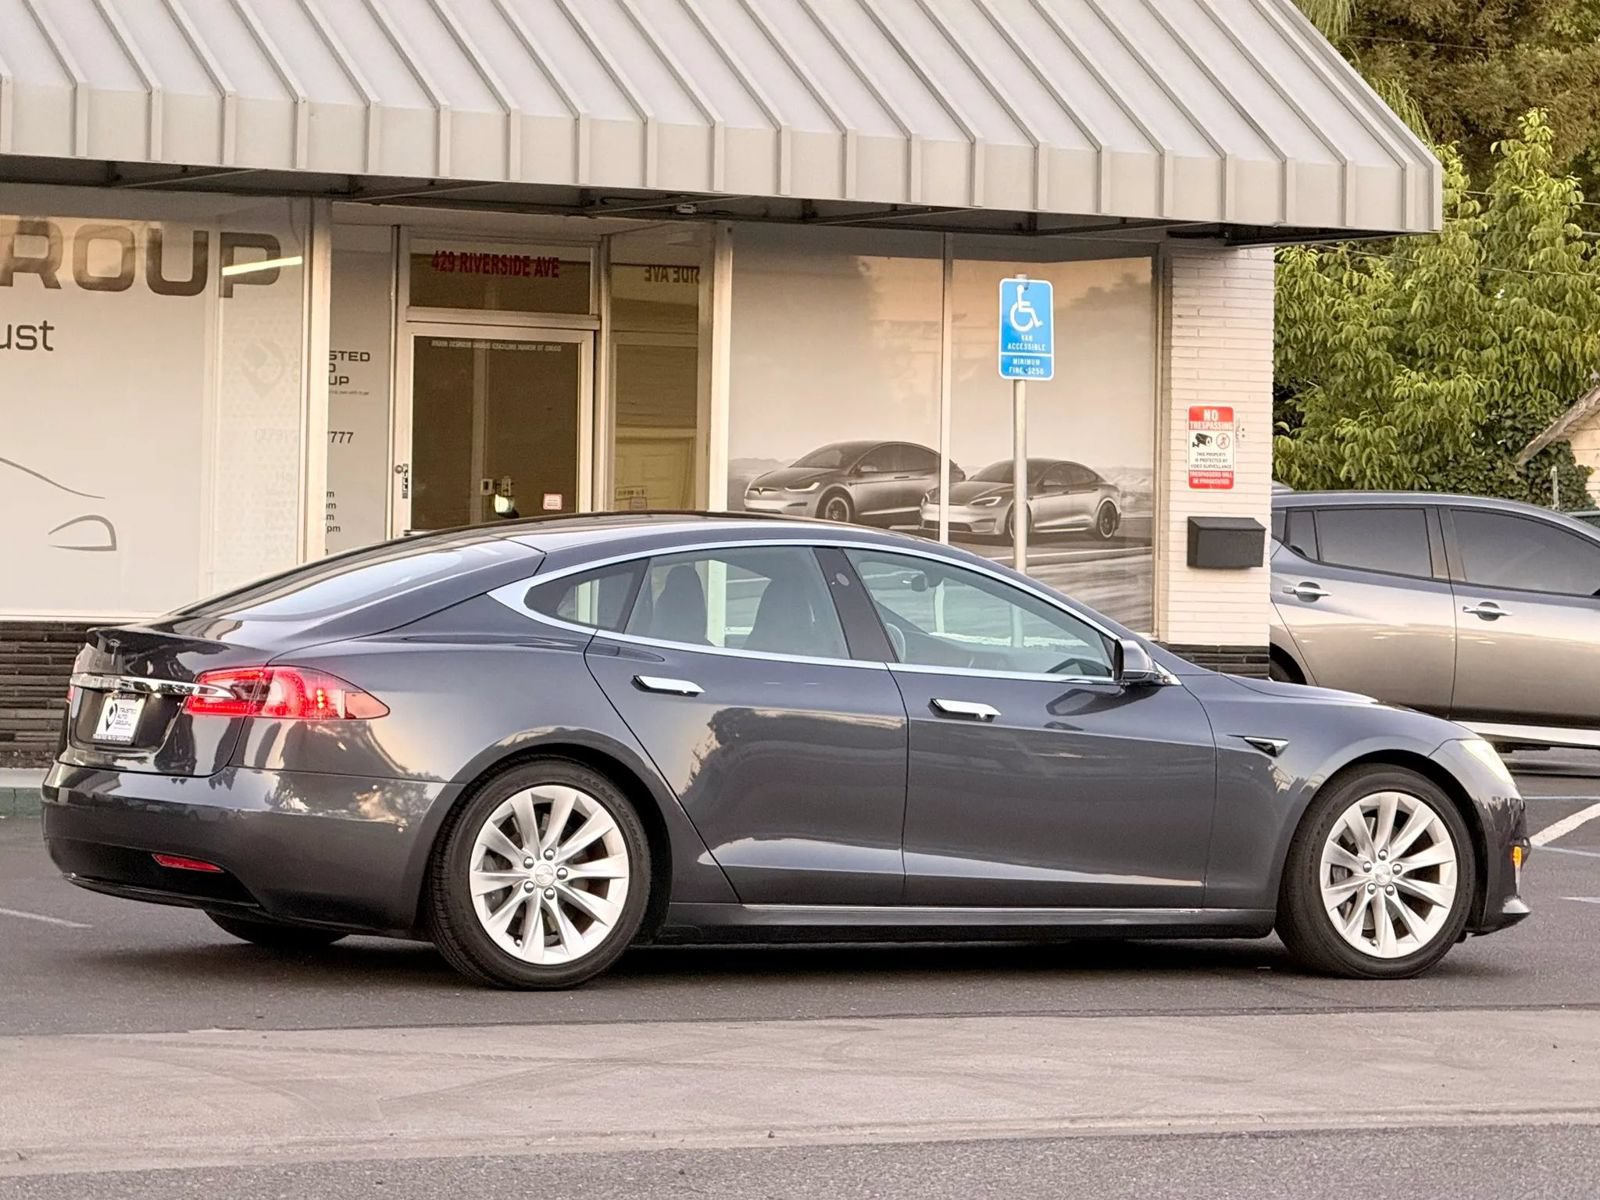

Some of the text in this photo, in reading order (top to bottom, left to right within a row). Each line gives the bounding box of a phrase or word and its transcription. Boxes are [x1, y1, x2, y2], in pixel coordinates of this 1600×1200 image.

[431, 250, 560, 278] 429 RIVERSIDE AVE
[1007, 342, 1047, 351] ACCESSIBLE
[329, 350, 371, 362] STED
[1203, 409, 1218, 421] NO
[328, 431, 354, 444] 777
[325, 523, 341, 534] pm
